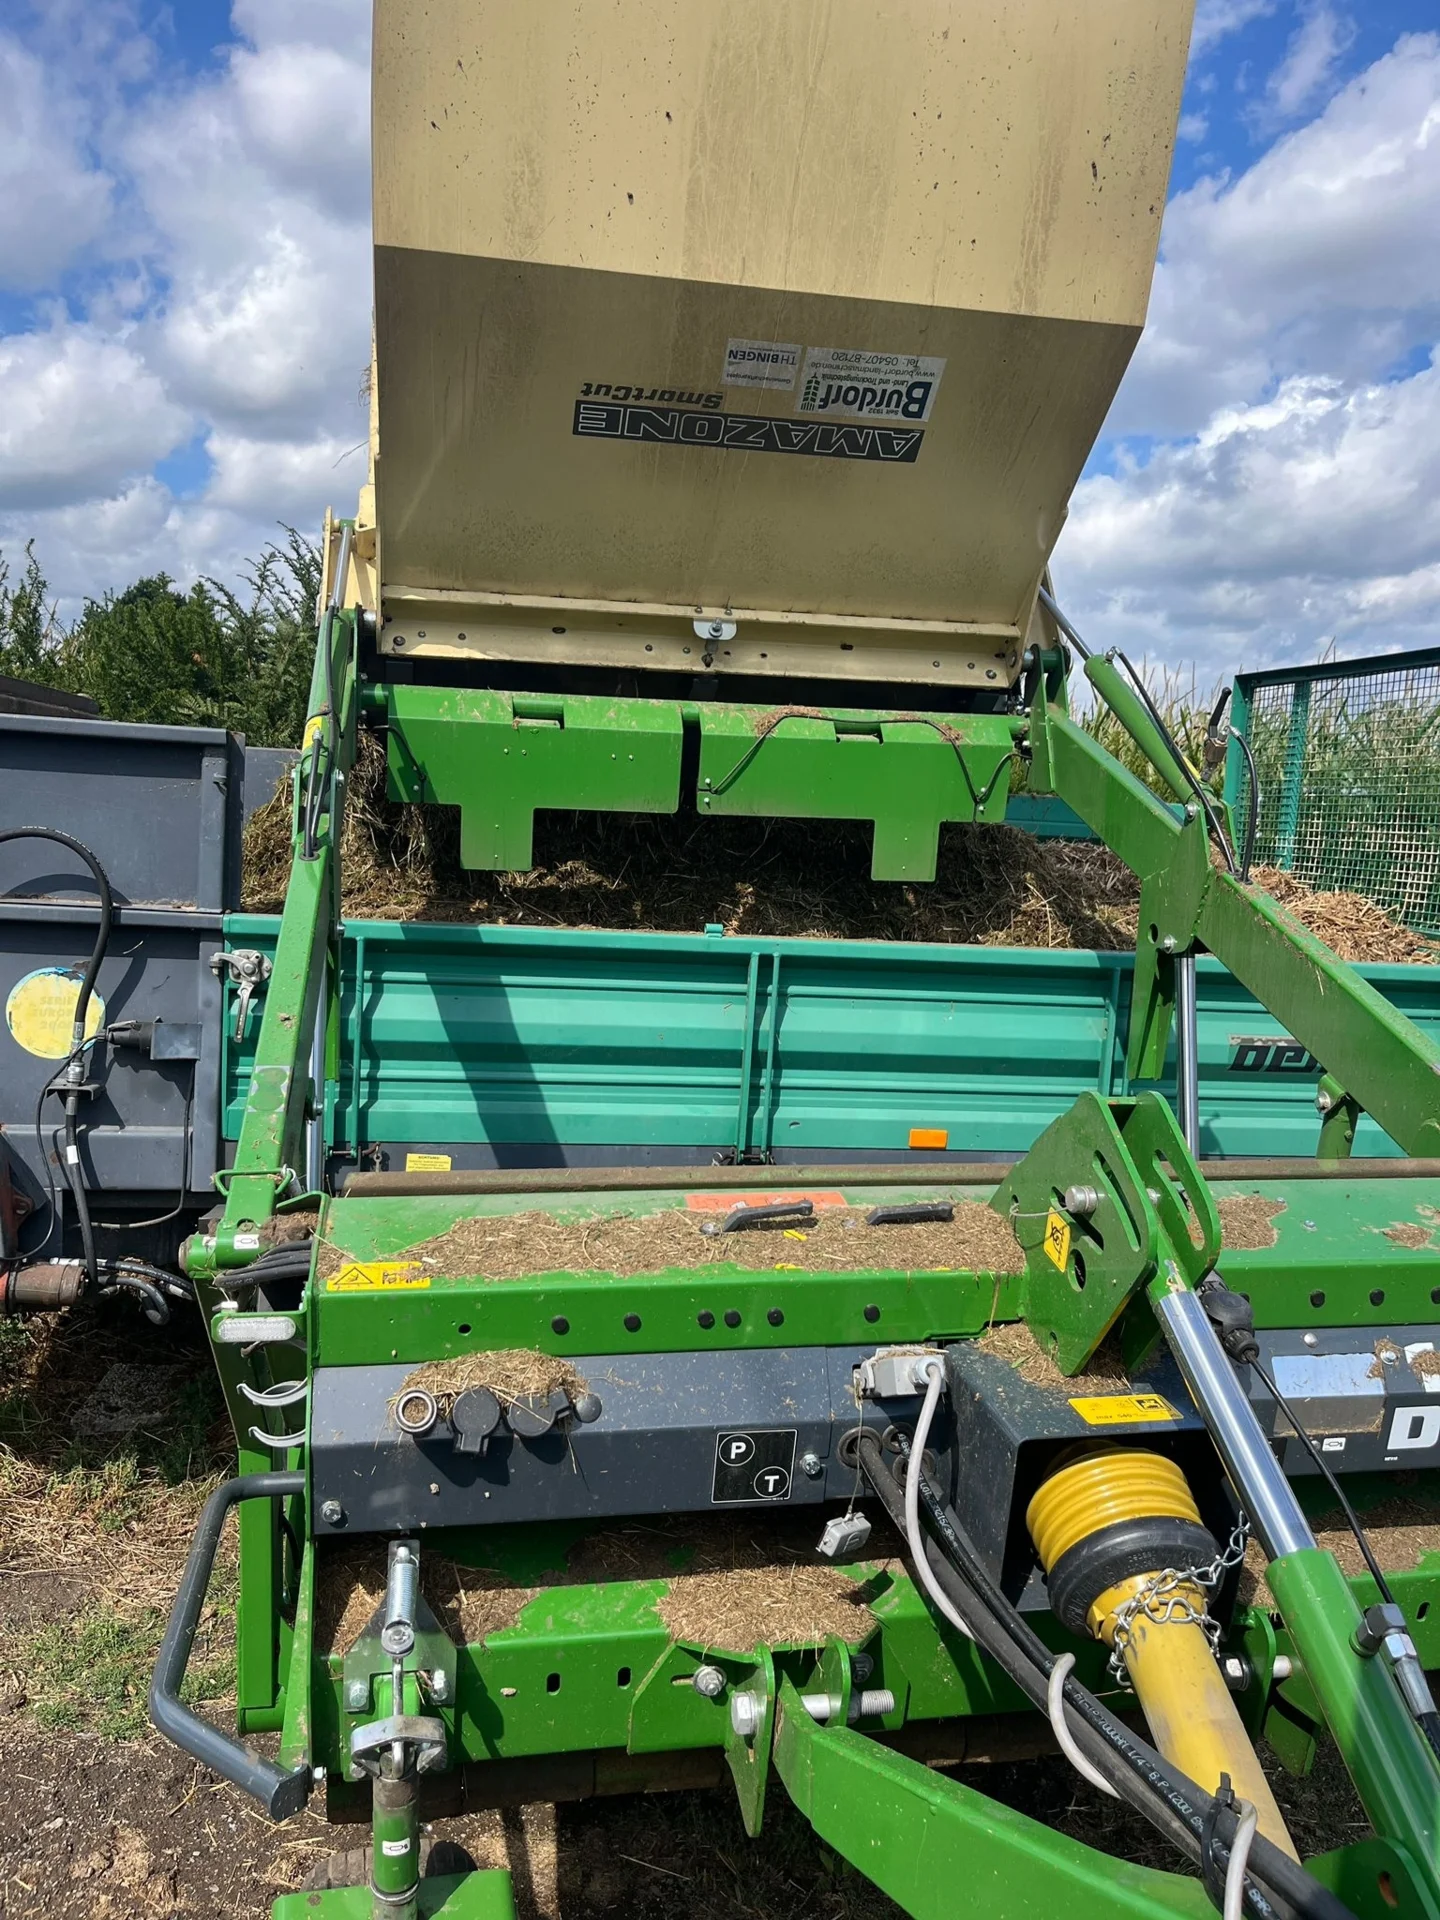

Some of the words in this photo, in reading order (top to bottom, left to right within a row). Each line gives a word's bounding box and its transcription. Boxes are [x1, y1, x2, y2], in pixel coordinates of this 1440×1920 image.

[728, 349, 780, 364] BINGEN
[780, 355, 797, 366] TH
[831, 351, 899, 365] 05407-87120
[810, 361, 936, 378] www.burdorf-landmaschinen.de
[821, 373, 880, 386] Trocknungstechnik
[880, 378, 891, 387] und
[891, 379, 909, 388] Land-
[580, 382, 724, 410] SmartCut
[818, 381, 933, 419] Burdorf
[885, 408, 899, 416] Seit
[578, 403, 921, 459] AMAZONE
[730, 1441, 747, 1460] P
[764, 1475, 780, 1493] T
